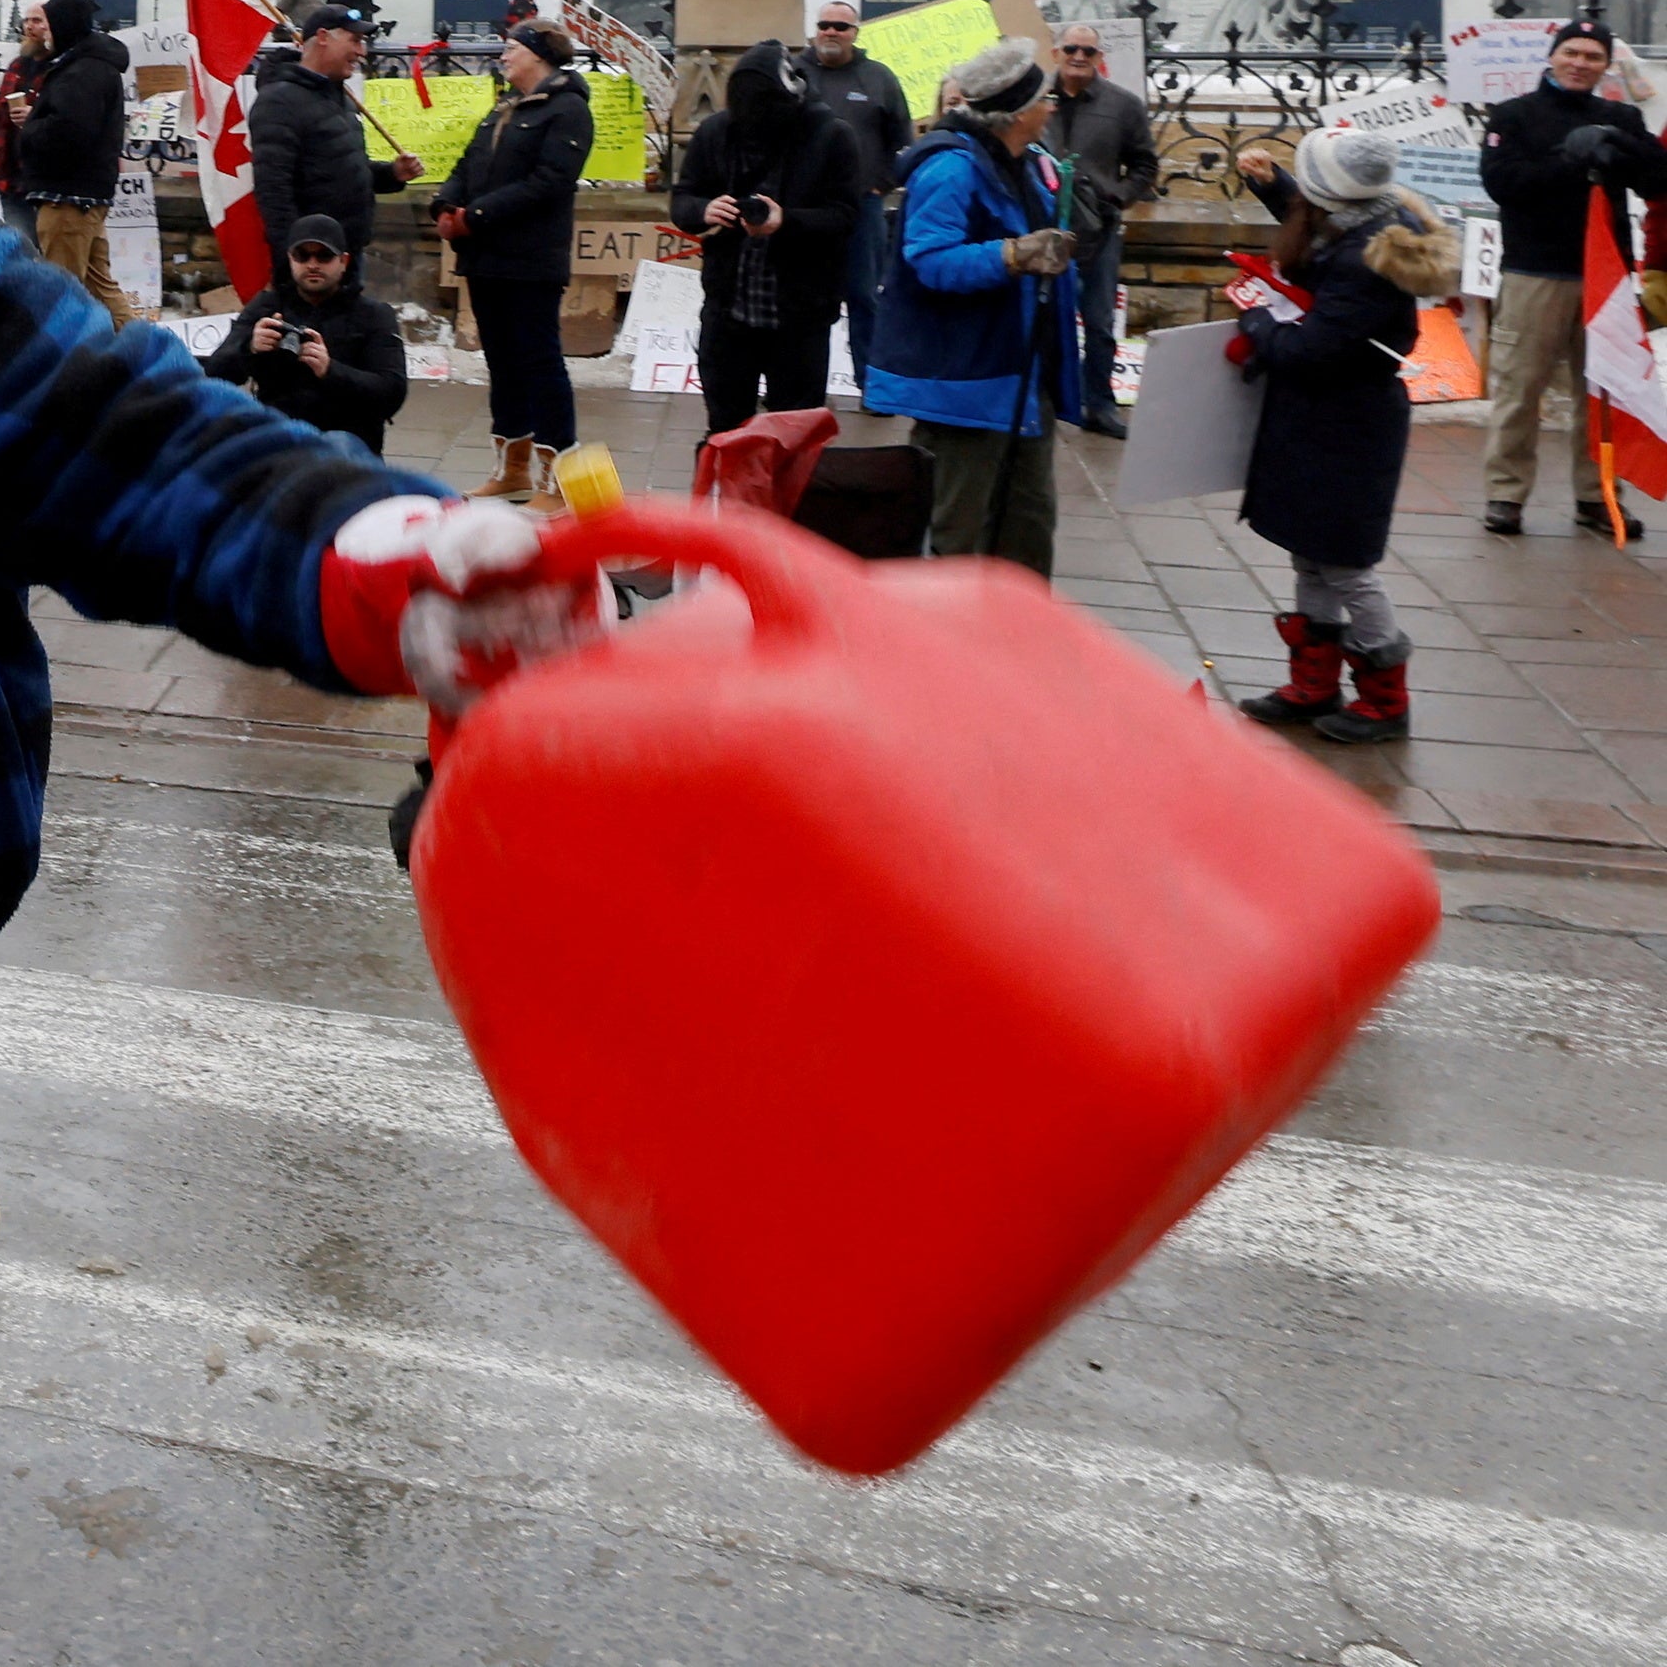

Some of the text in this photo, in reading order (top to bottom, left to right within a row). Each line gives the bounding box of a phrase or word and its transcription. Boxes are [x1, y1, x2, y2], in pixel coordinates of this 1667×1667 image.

[1352, 97, 1432, 130] TRADES &
[577, 230, 643, 259] EAT
